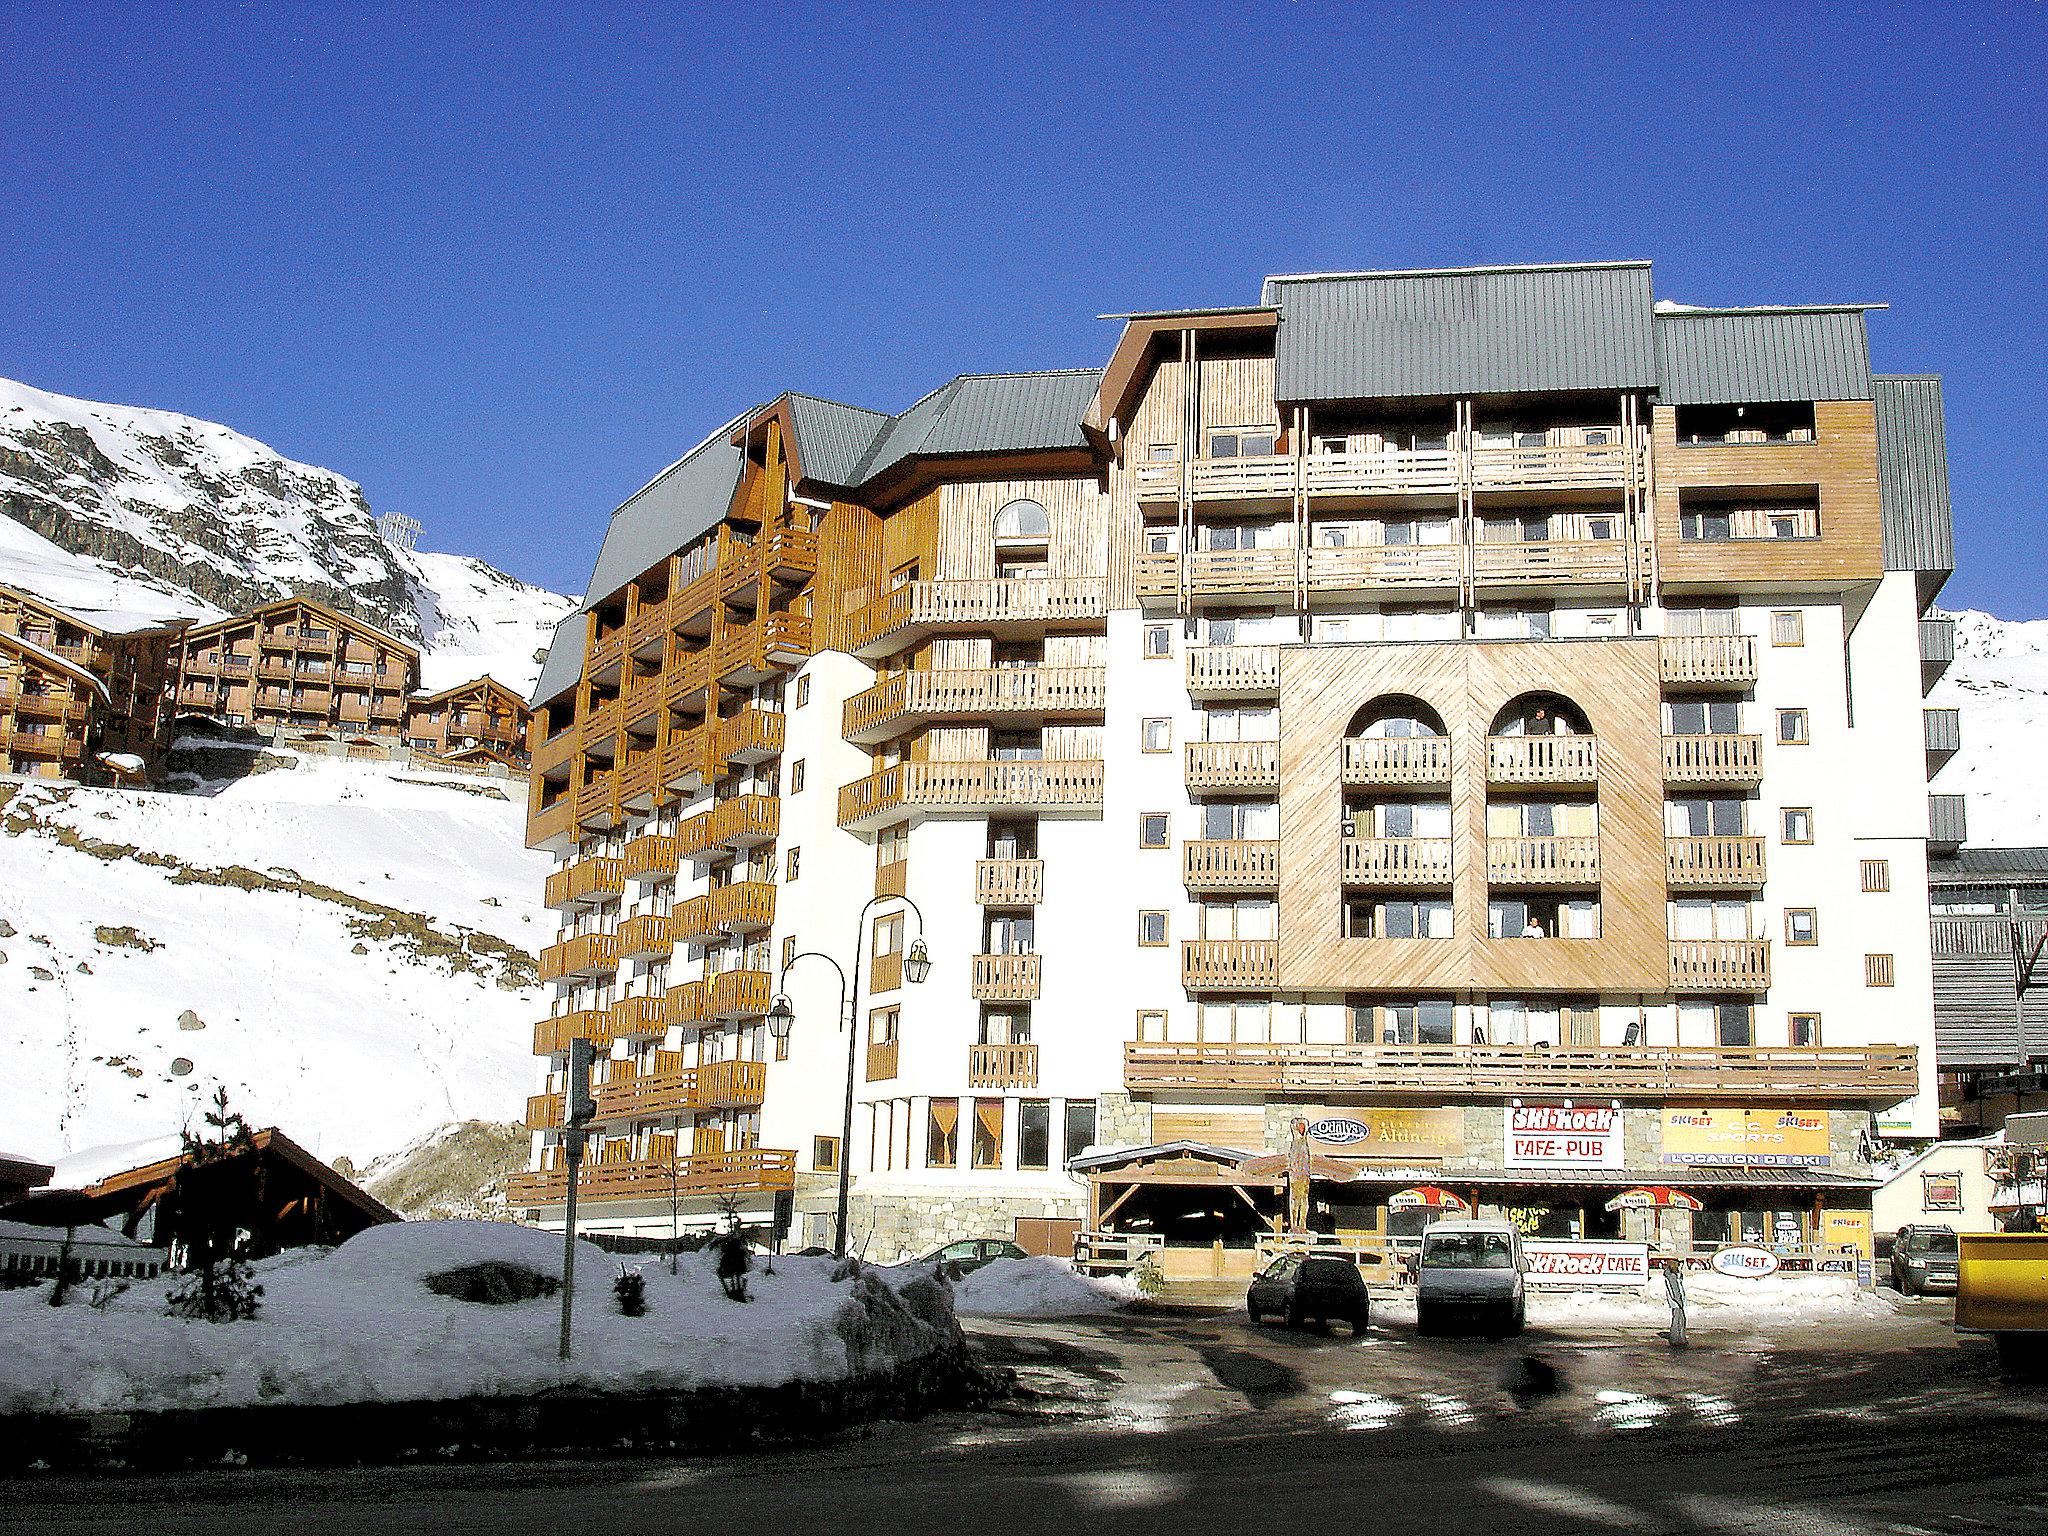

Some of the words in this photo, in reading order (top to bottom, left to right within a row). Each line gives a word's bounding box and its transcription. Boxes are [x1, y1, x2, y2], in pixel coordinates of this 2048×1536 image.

[1671, 1115, 1713, 1126] SKISET
[1777, 1117, 1820, 1127] SKISET
[1707, 1133, 1785, 1144] SPORTS
[1566, 1140, 1603, 1156] PUB
[1671, 1153, 1759, 1165] LOCATION
[1764, 1155, 1788, 1165] DE
[1792, 1156, 1820, 1166] SKI
[1607, 1257, 1641, 1272] CAFE
[1722, 1254, 1768, 1268] SKISET
